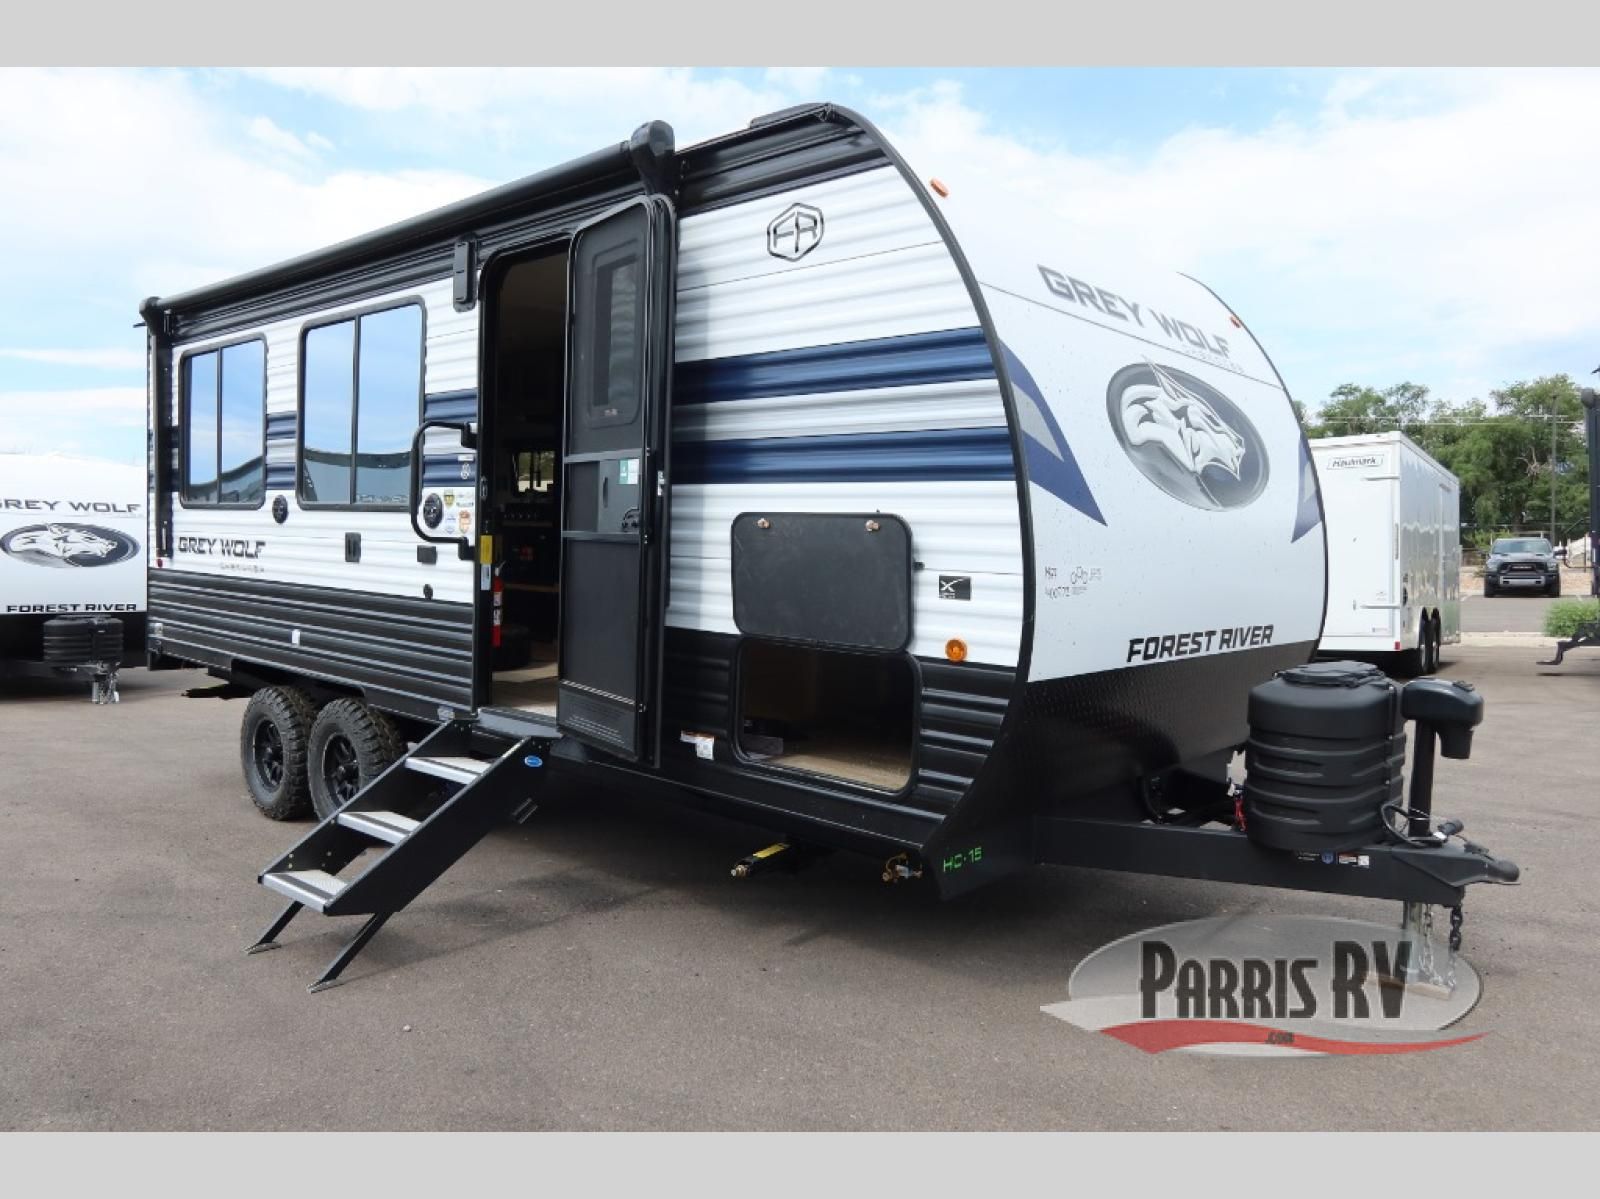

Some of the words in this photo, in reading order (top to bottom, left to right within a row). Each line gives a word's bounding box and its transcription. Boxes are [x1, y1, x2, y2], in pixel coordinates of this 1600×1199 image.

[1036, 264, 1145, 328] GREY
[1148, 307, 1230, 359] WOLF
[0, 498, 61, 511] REY
[68, 501, 141, 513] WOLF
[178, 536, 217, 555] GREY
[219, 538, 266, 559] WOLF
[7, 603, 80, 613] FOREST
[85, 603, 137, 612] RIVER
[1126, 629, 1217, 663] FOREST
[1219, 623, 1275, 651] RIVER
